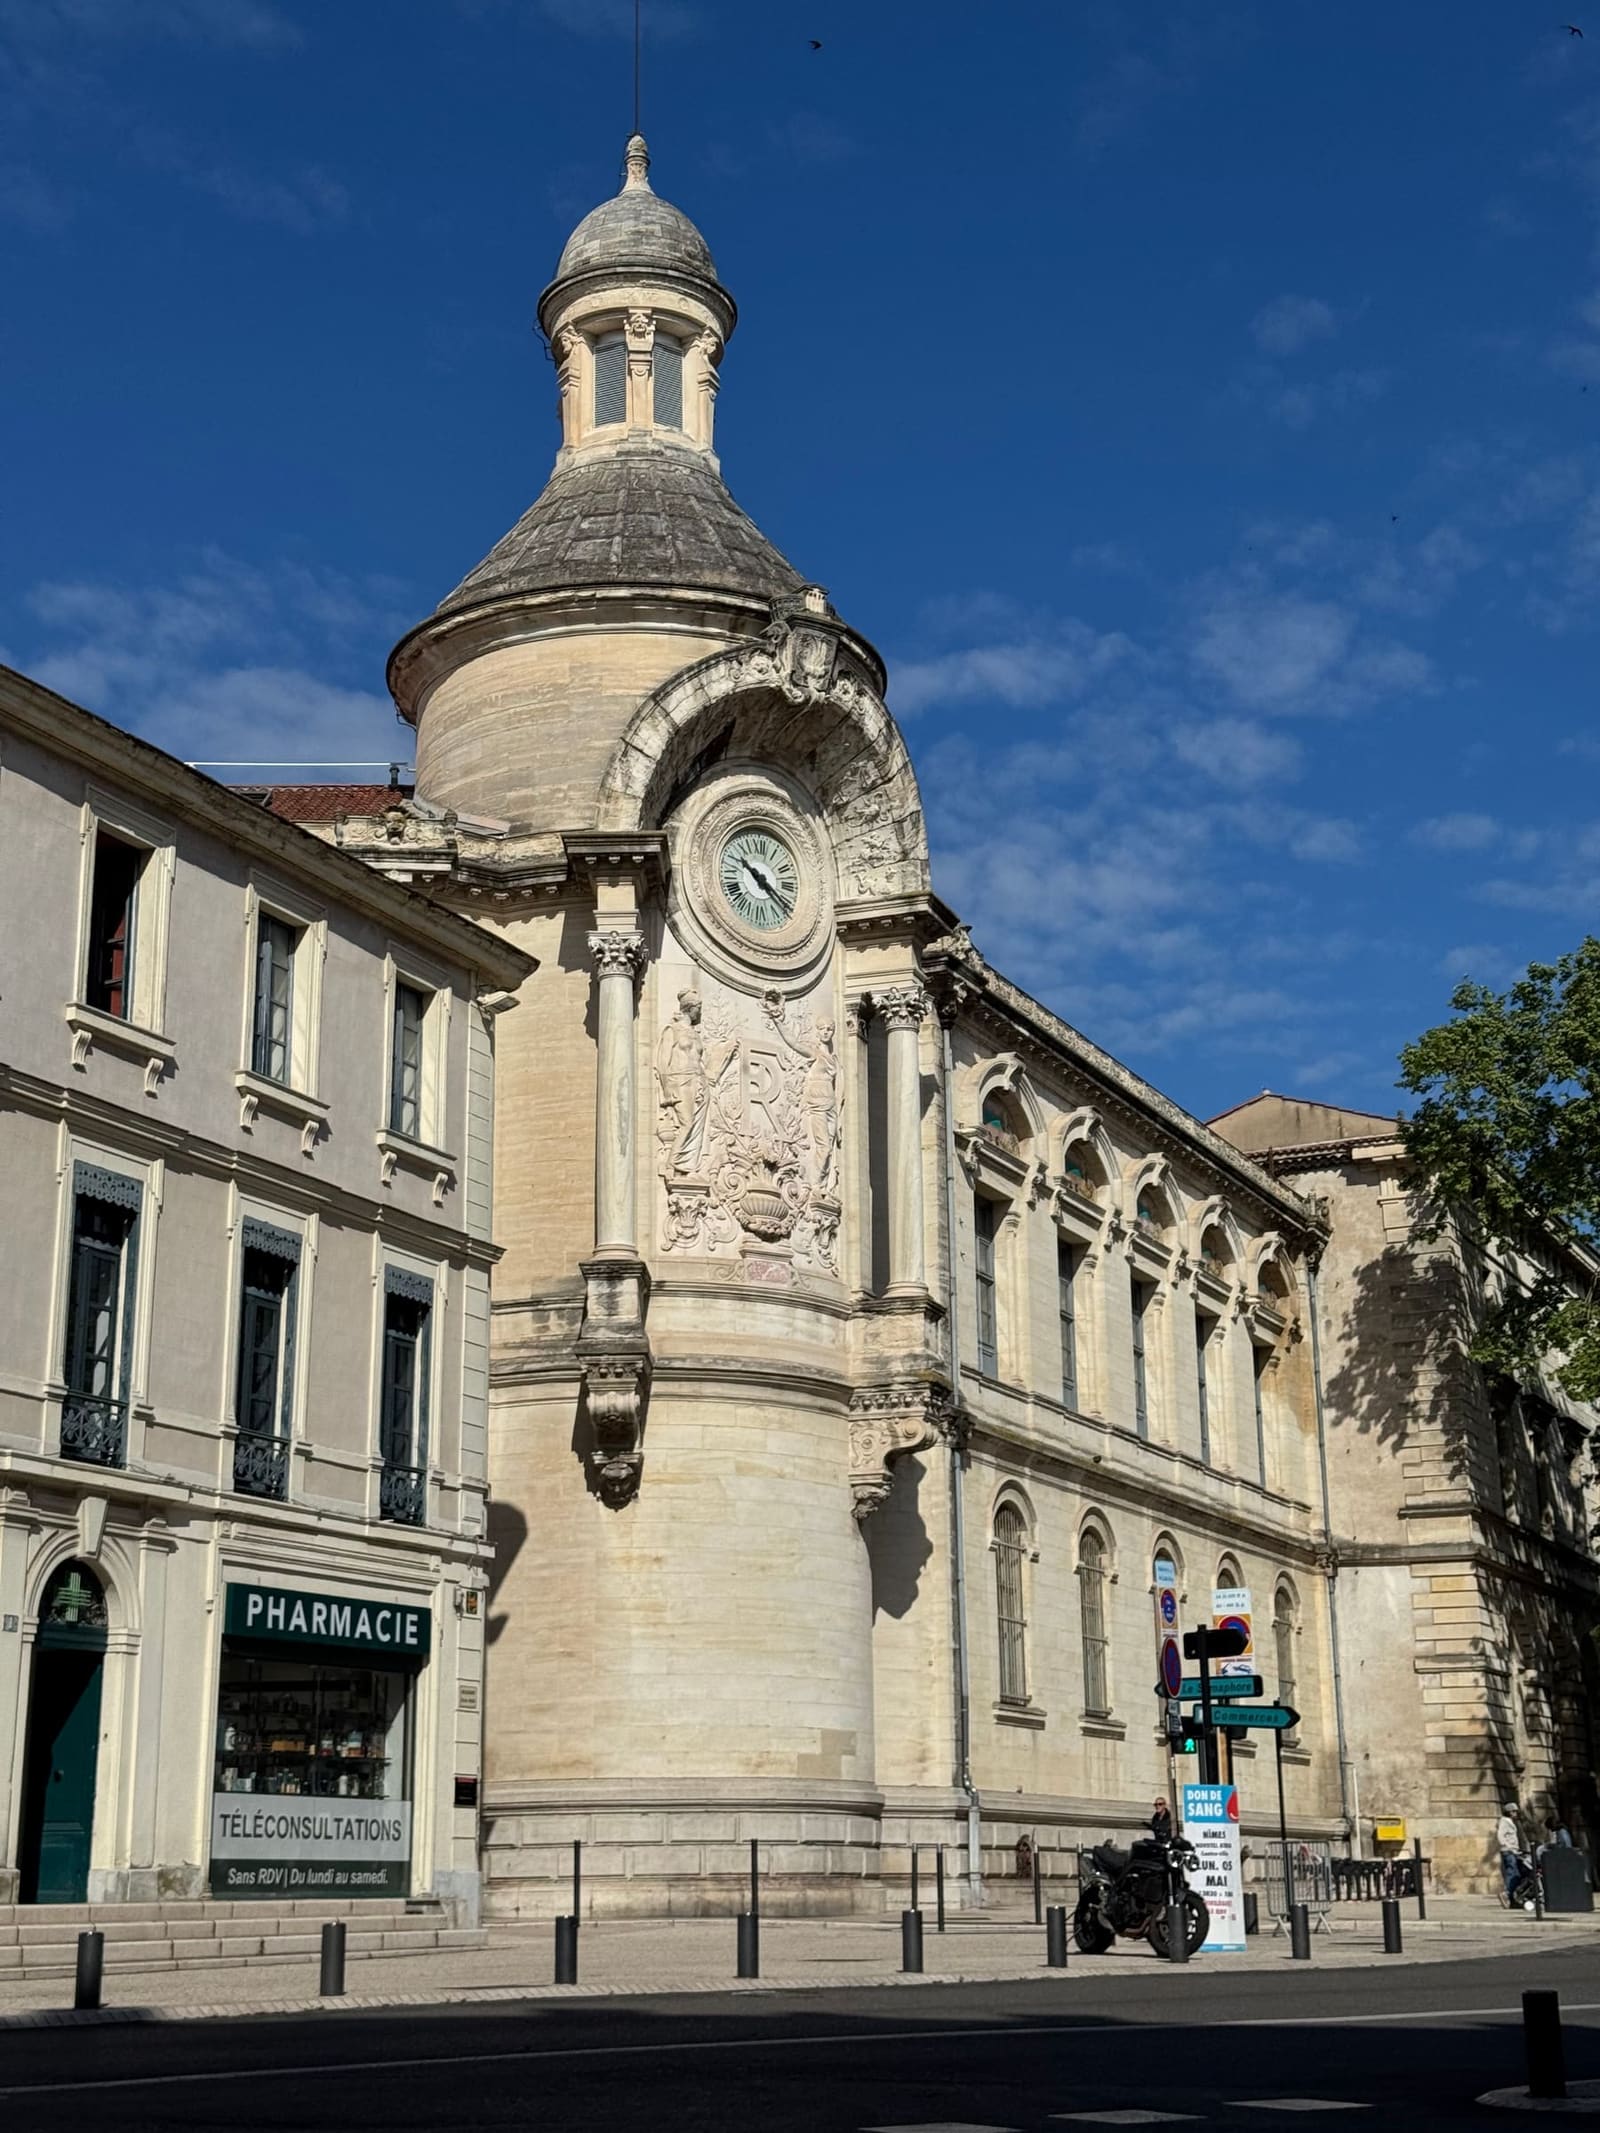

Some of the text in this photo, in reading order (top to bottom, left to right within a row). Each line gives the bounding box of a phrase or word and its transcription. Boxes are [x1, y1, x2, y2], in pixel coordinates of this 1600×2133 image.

[246, 1593, 420, 1645] PHARMACIE
[1199, 1681, 1252, 1694] Smaphore
[1214, 1710, 1279, 1722] Commerces
[1186, 1790, 1222, 1801] DON DE
[1188, 1803, 1223, 1817] SANG
[219, 1808, 402, 1842] TÉLÉCONSULTATIONS
[1222, 1861, 1232, 1871] 05
[227, 1868, 256, 1885] Sans
[257, 1868, 283, 1885] RDV
[290, 1869, 305, 1885] Du
[307, 1868, 334, 1885] lundi
[335, 1874, 349, 1885] au
[350, 1869, 388, 1885] samedi.
[1206, 1876, 1227, 1886] MAI
